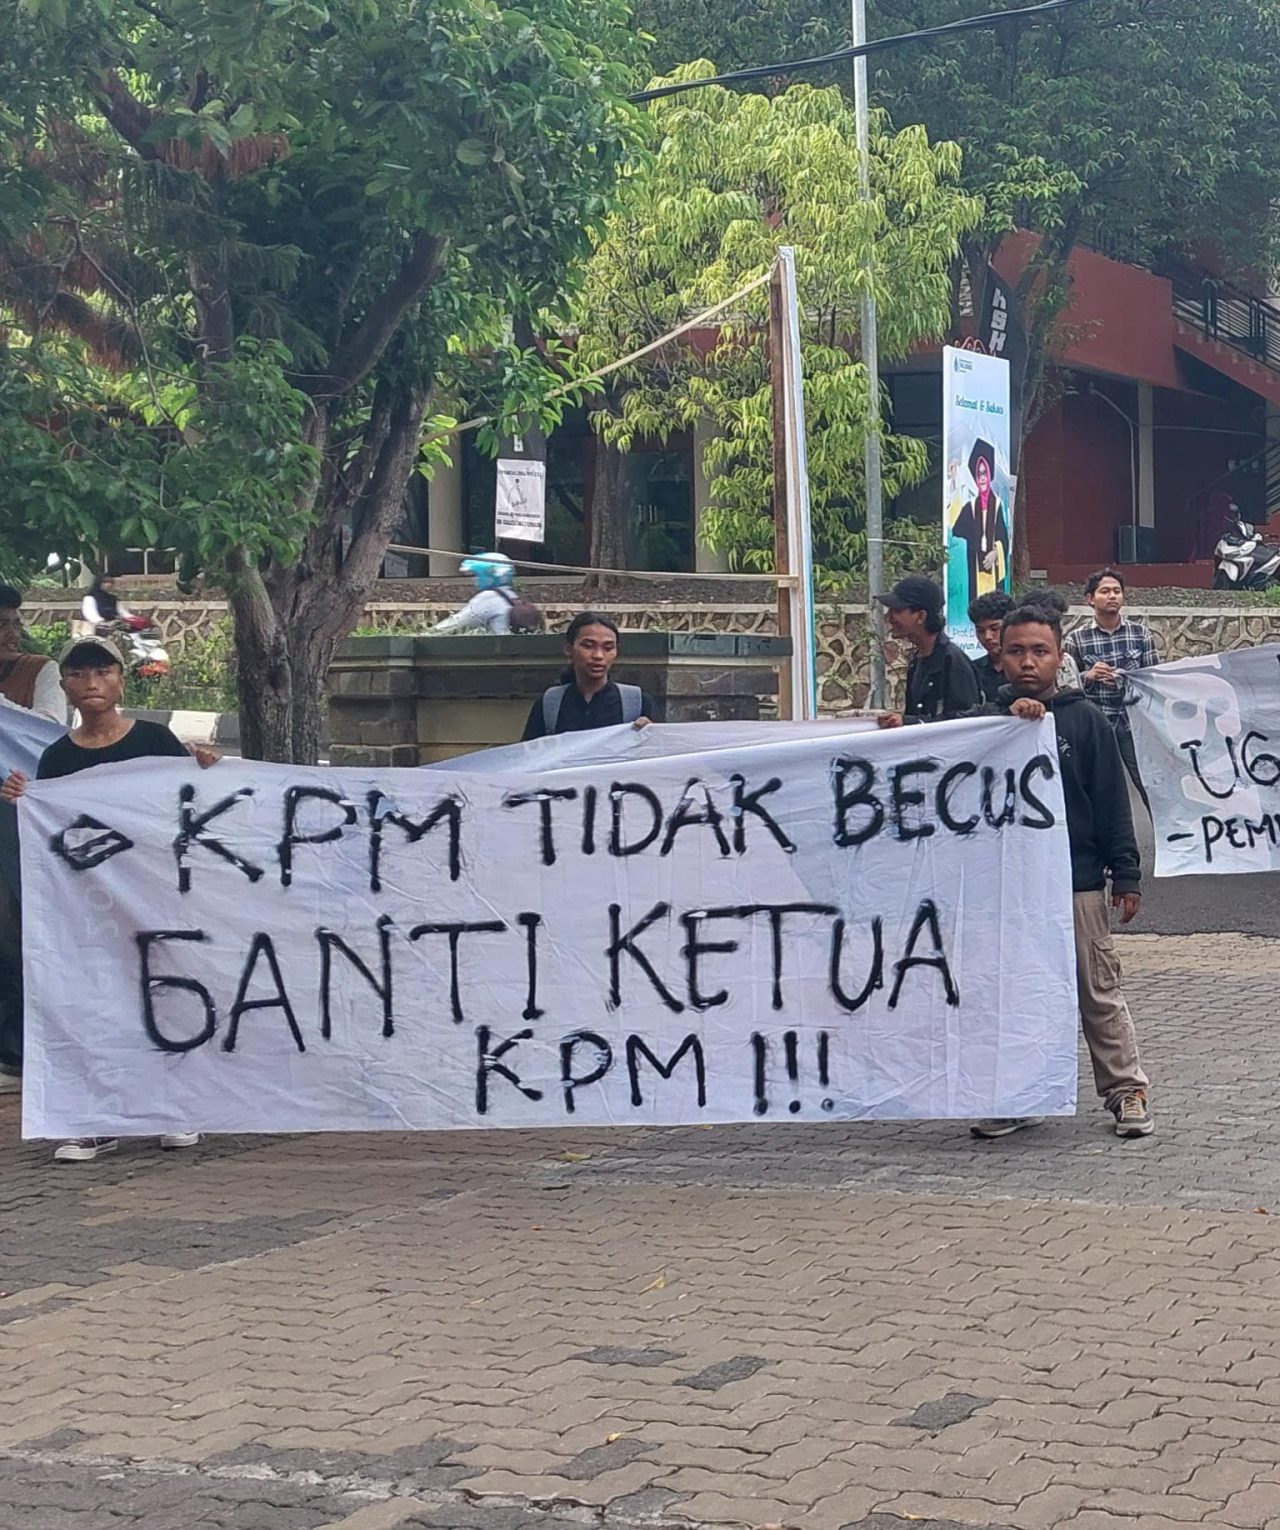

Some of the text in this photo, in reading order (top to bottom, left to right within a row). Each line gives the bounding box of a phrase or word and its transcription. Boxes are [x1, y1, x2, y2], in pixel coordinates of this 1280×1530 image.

[172, 753, 1056, 894] KPM TIDAK BECUS
[604, 897, 961, 1013] KETUA
[473, 1025, 707, 1115] KPM
